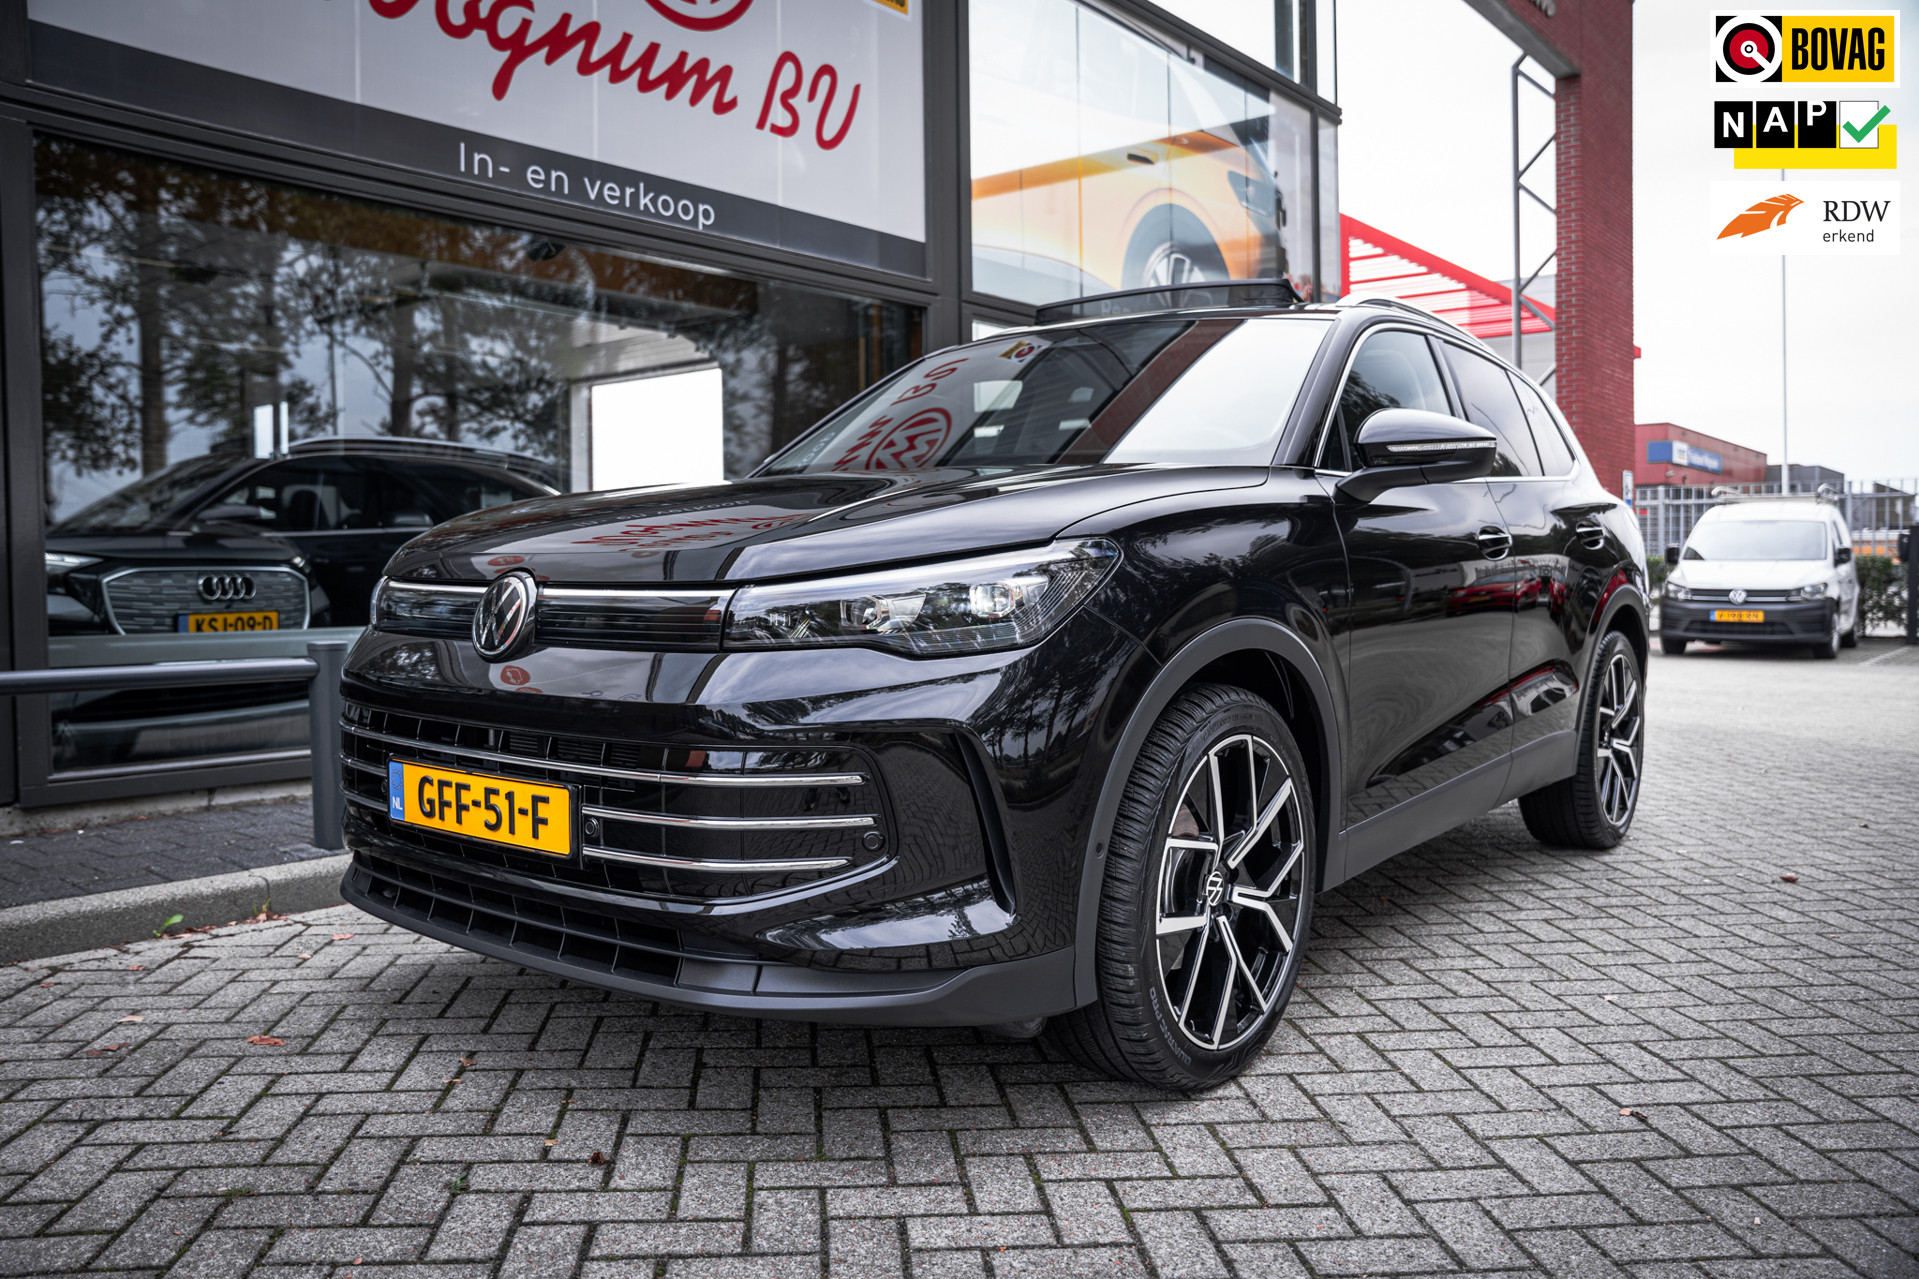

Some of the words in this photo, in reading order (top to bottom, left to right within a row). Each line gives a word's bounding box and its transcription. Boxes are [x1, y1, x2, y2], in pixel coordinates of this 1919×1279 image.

[755, 50, 861, 151] BV
[458, 142, 511, 179] In-
[527, 163, 570, 195] en
[583, 176, 716, 231] verkoop
[391, 796, 403, 811] NL
[417, 774, 549, 841] GFF-51-F
